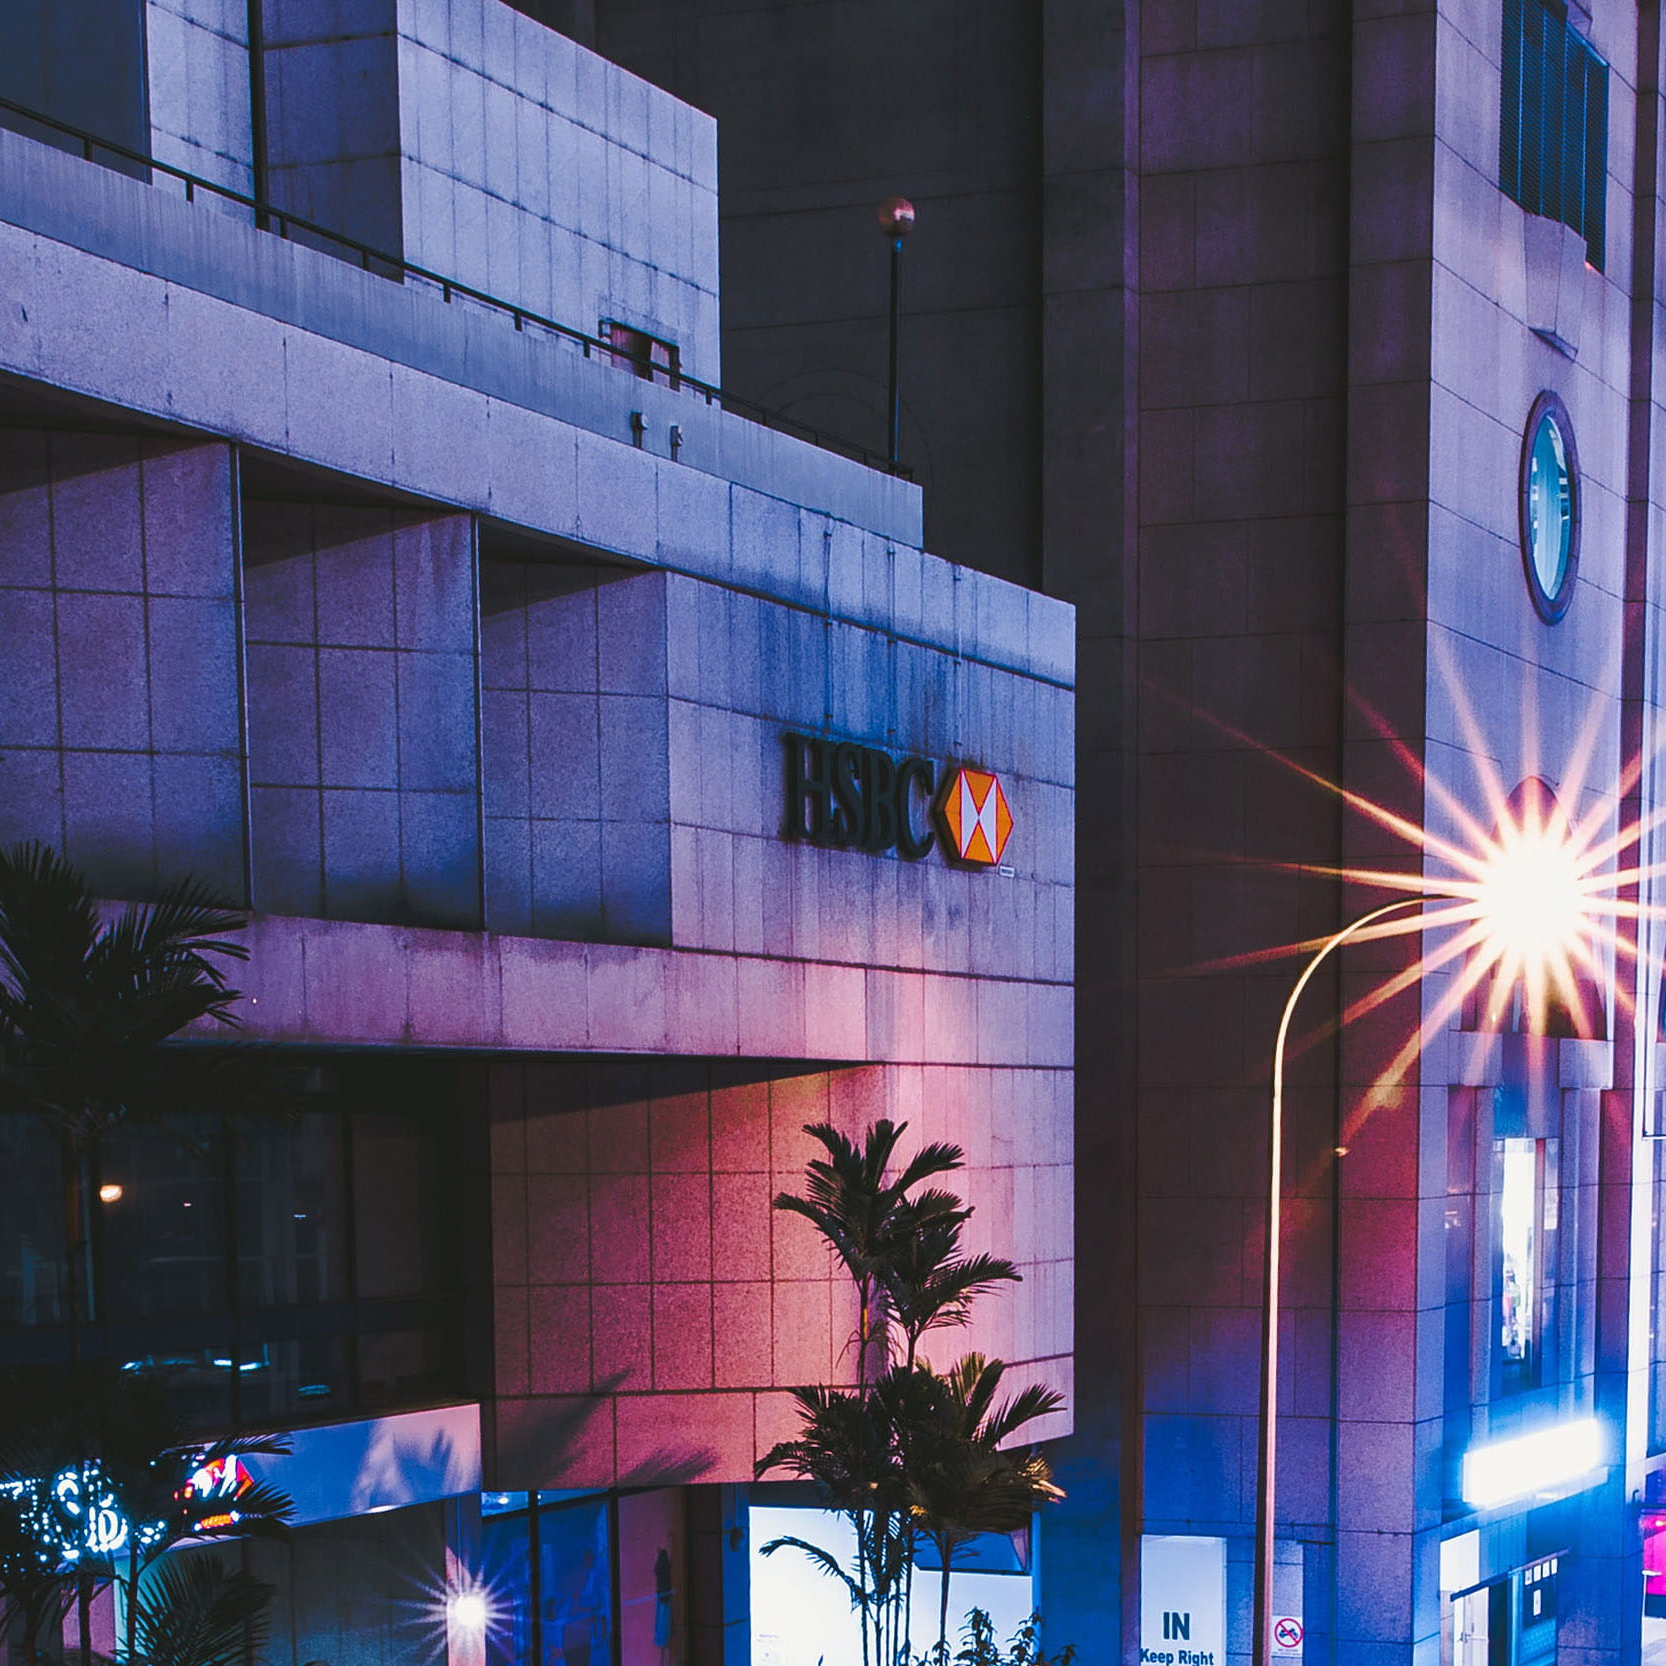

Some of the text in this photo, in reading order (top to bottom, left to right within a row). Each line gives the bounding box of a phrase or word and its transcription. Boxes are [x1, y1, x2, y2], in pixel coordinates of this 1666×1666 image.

[780, 731, 935, 859] HSBC
[1163, 1611, 1190, 1640] IN
[1140, 1648, 1174, 1666] Keep
